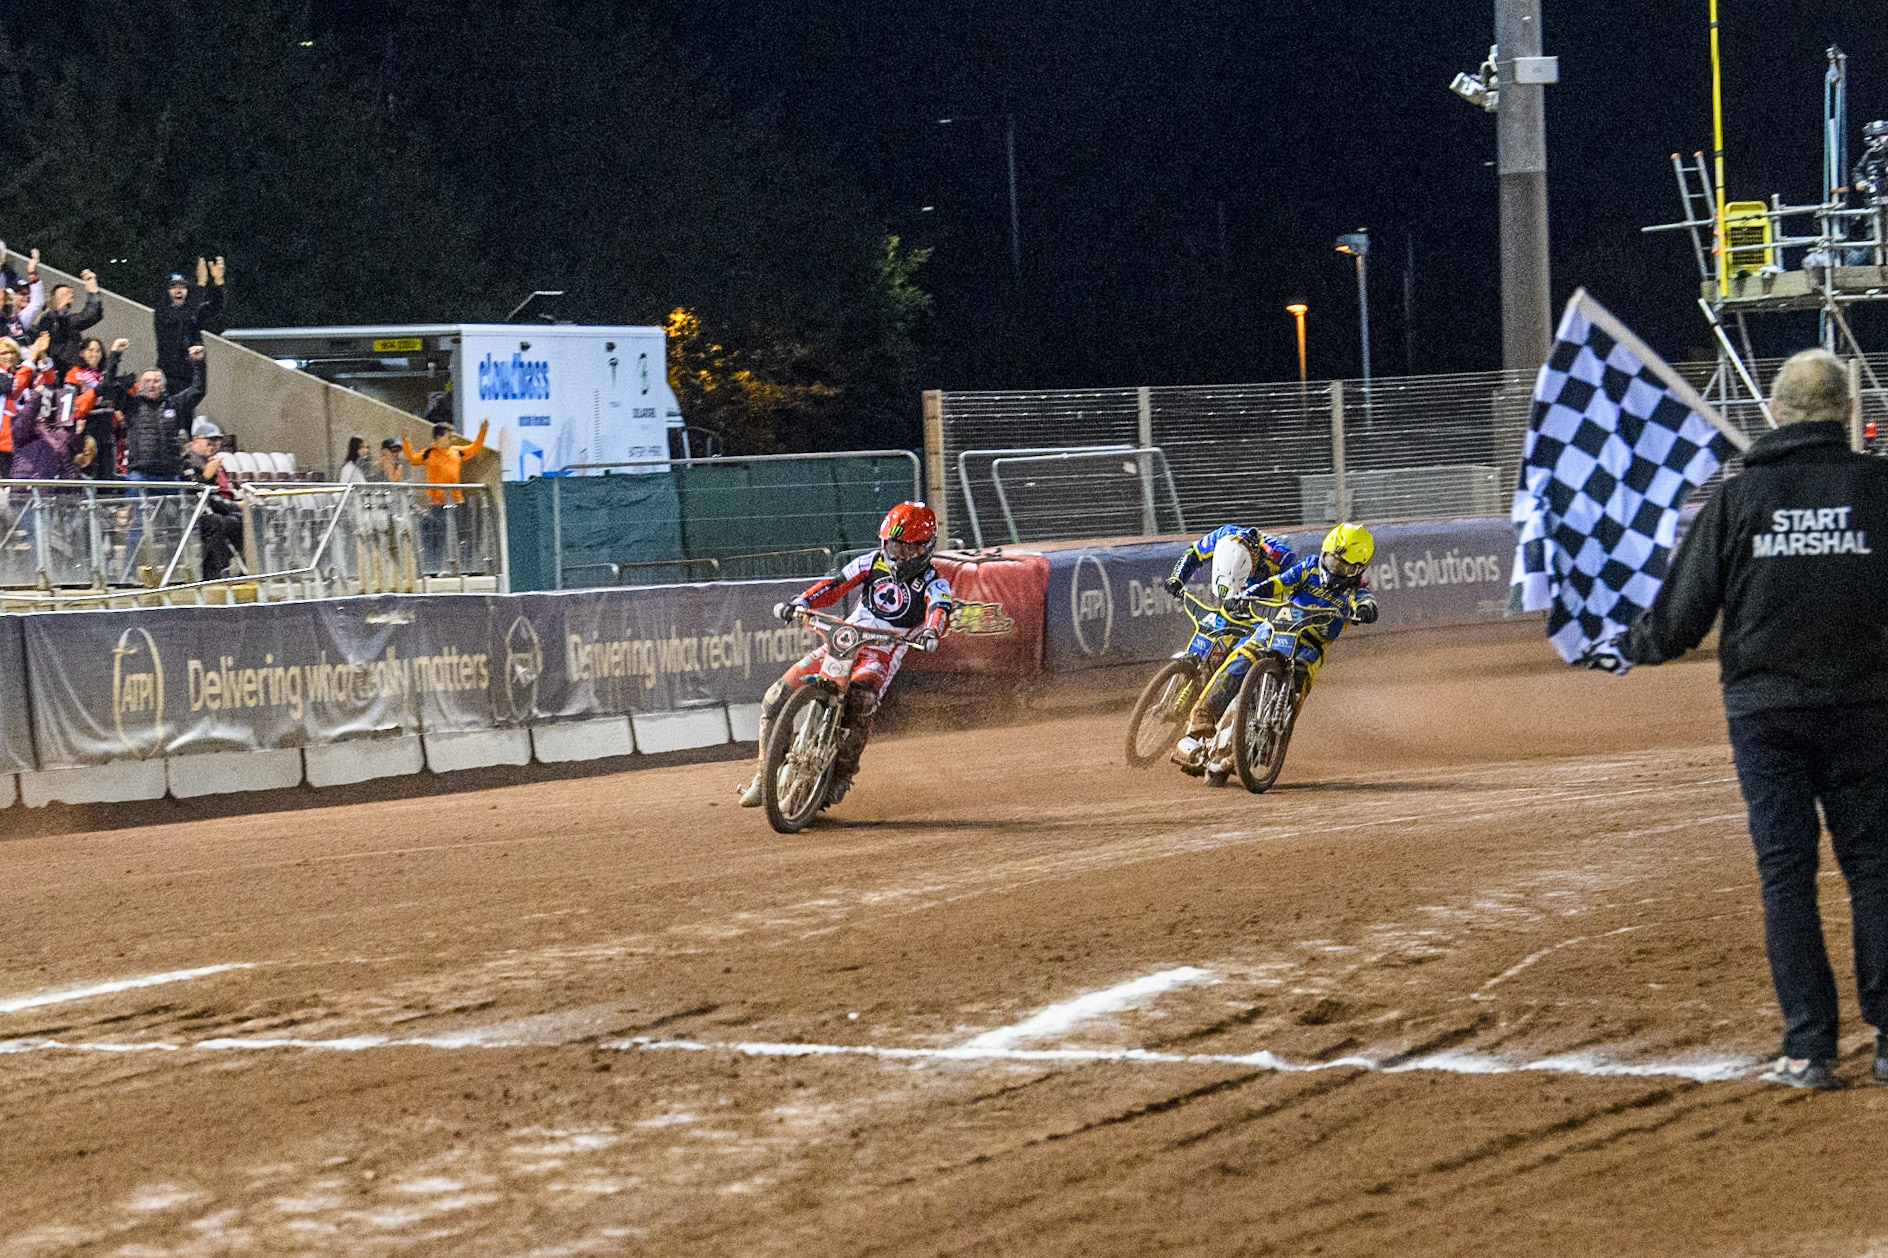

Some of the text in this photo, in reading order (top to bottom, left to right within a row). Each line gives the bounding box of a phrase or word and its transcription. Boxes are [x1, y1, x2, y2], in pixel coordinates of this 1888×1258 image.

[1772, 506, 1852, 532] START
[1753, 531, 1872, 557] MARSHAL
[1404, 547, 1501, 589] solutions
[566, 627, 656, 690] Delivering
[701, 619, 752, 680] really
[120, 672, 154, 713] ATPI
[187, 655, 304, 720] Delivering
[412, 645, 491, 694] matters
